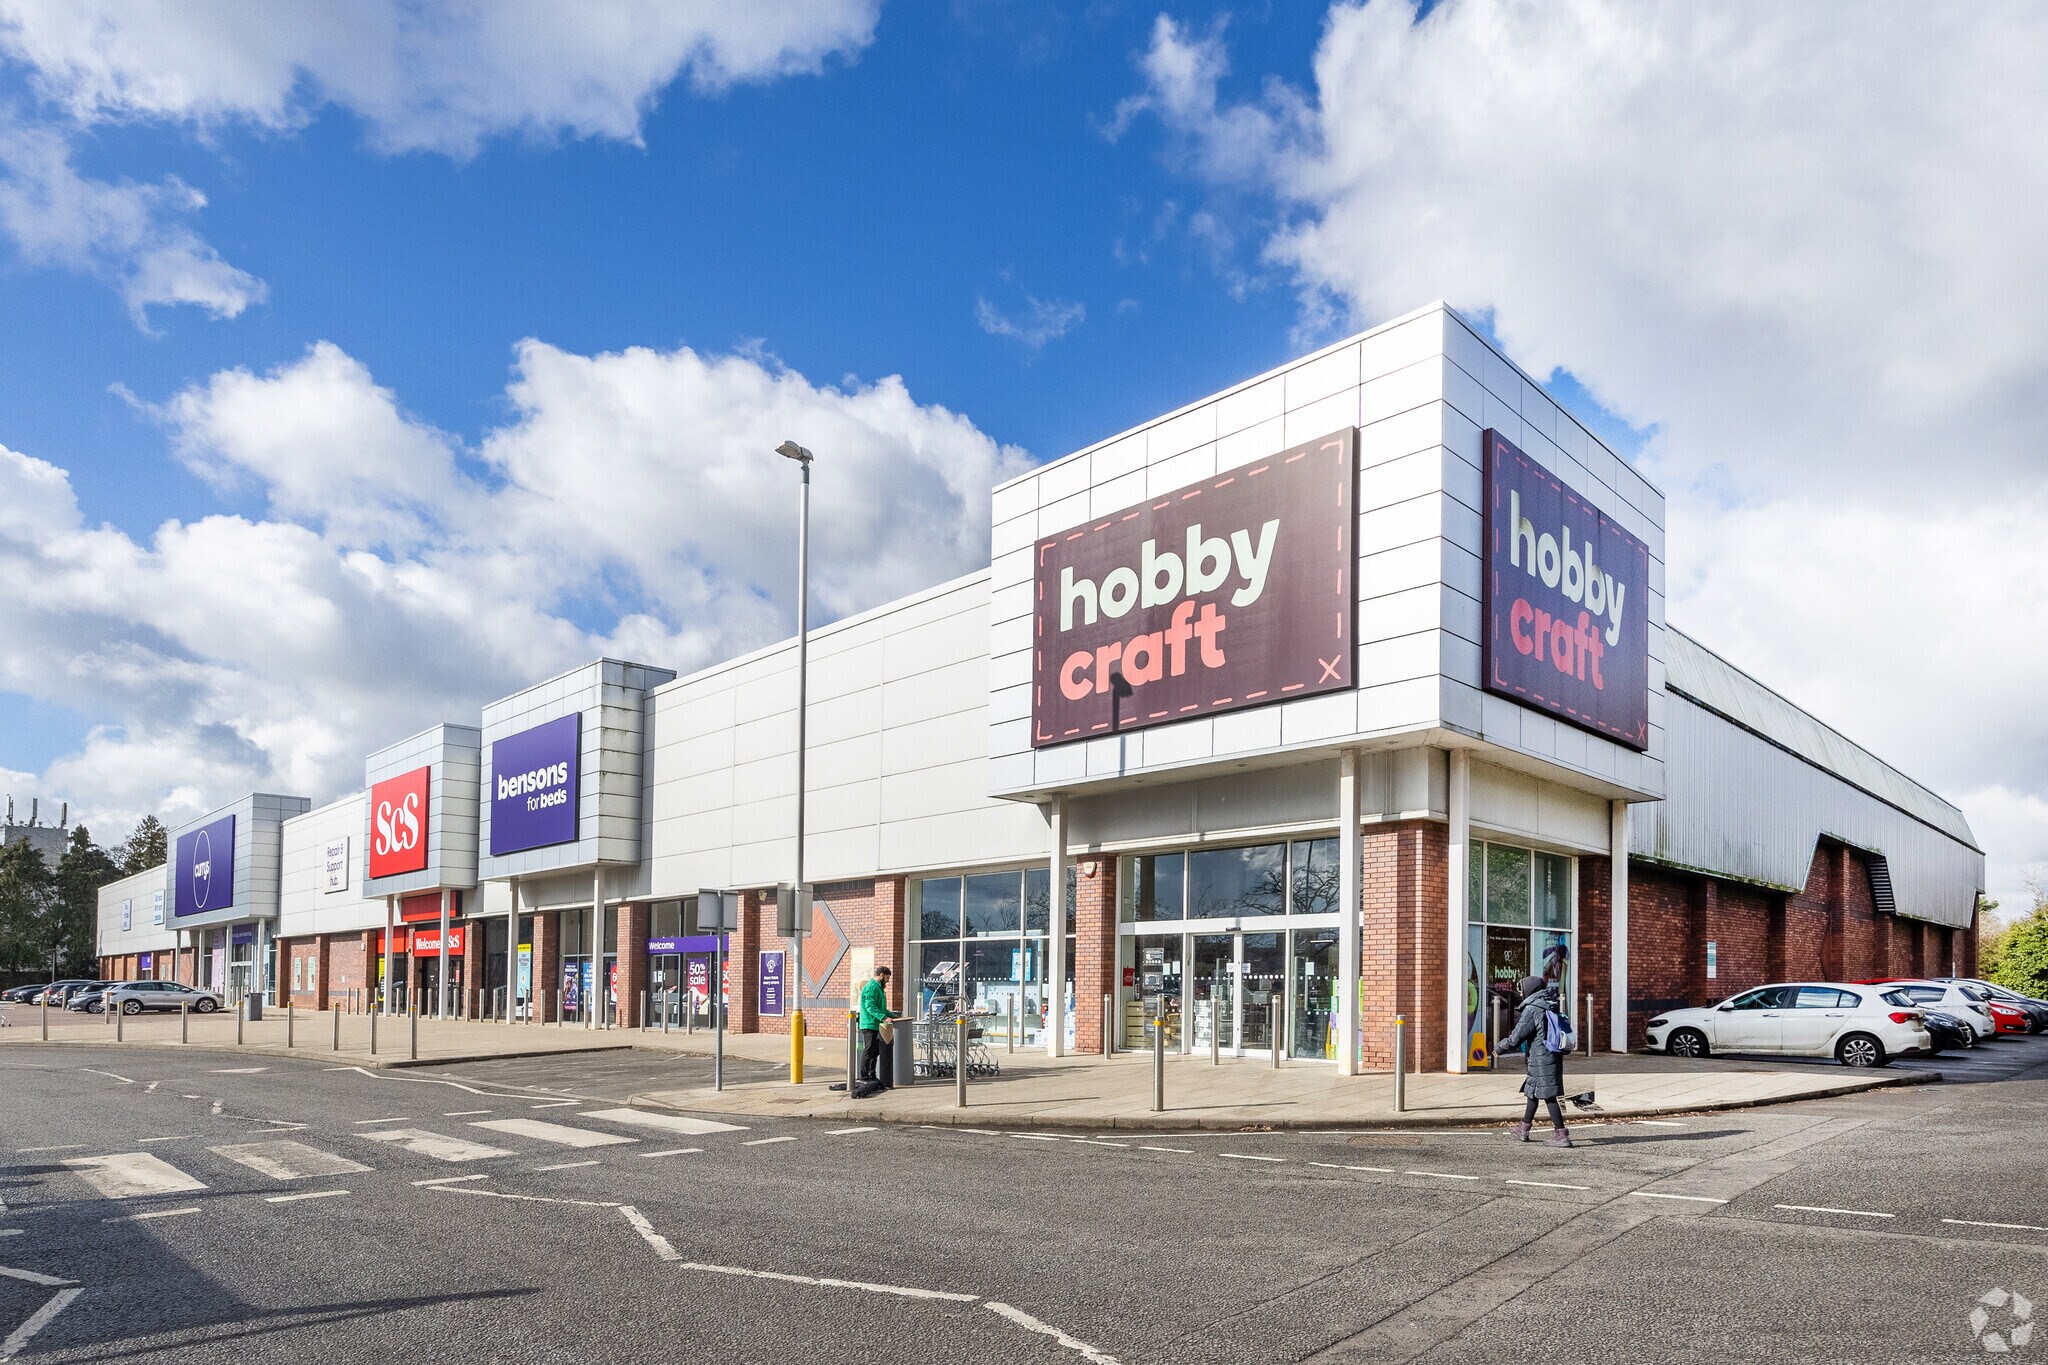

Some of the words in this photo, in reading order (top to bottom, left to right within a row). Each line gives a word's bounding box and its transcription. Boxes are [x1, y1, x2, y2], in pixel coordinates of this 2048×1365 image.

[1059, 518, 1280, 633] hobby
[1510, 488, 1626, 648] hobby
[1059, 599, 1226, 701] craft
[1509, 597, 1604, 691] craft
[497, 761, 568, 801] bensons
[526, 796, 540, 812] for
[540, 788, 567, 809] beds
[375, 792, 419, 856] ScS
[195, 861, 210, 881] currys
[415, 937, 441, 951] Welcome
[448, 934, 460, 949] ScS
[648, 941, 675, 950] Welcome
[689, 975, 706, 985] sale
[1495, 966, 1517, 982] hobby
